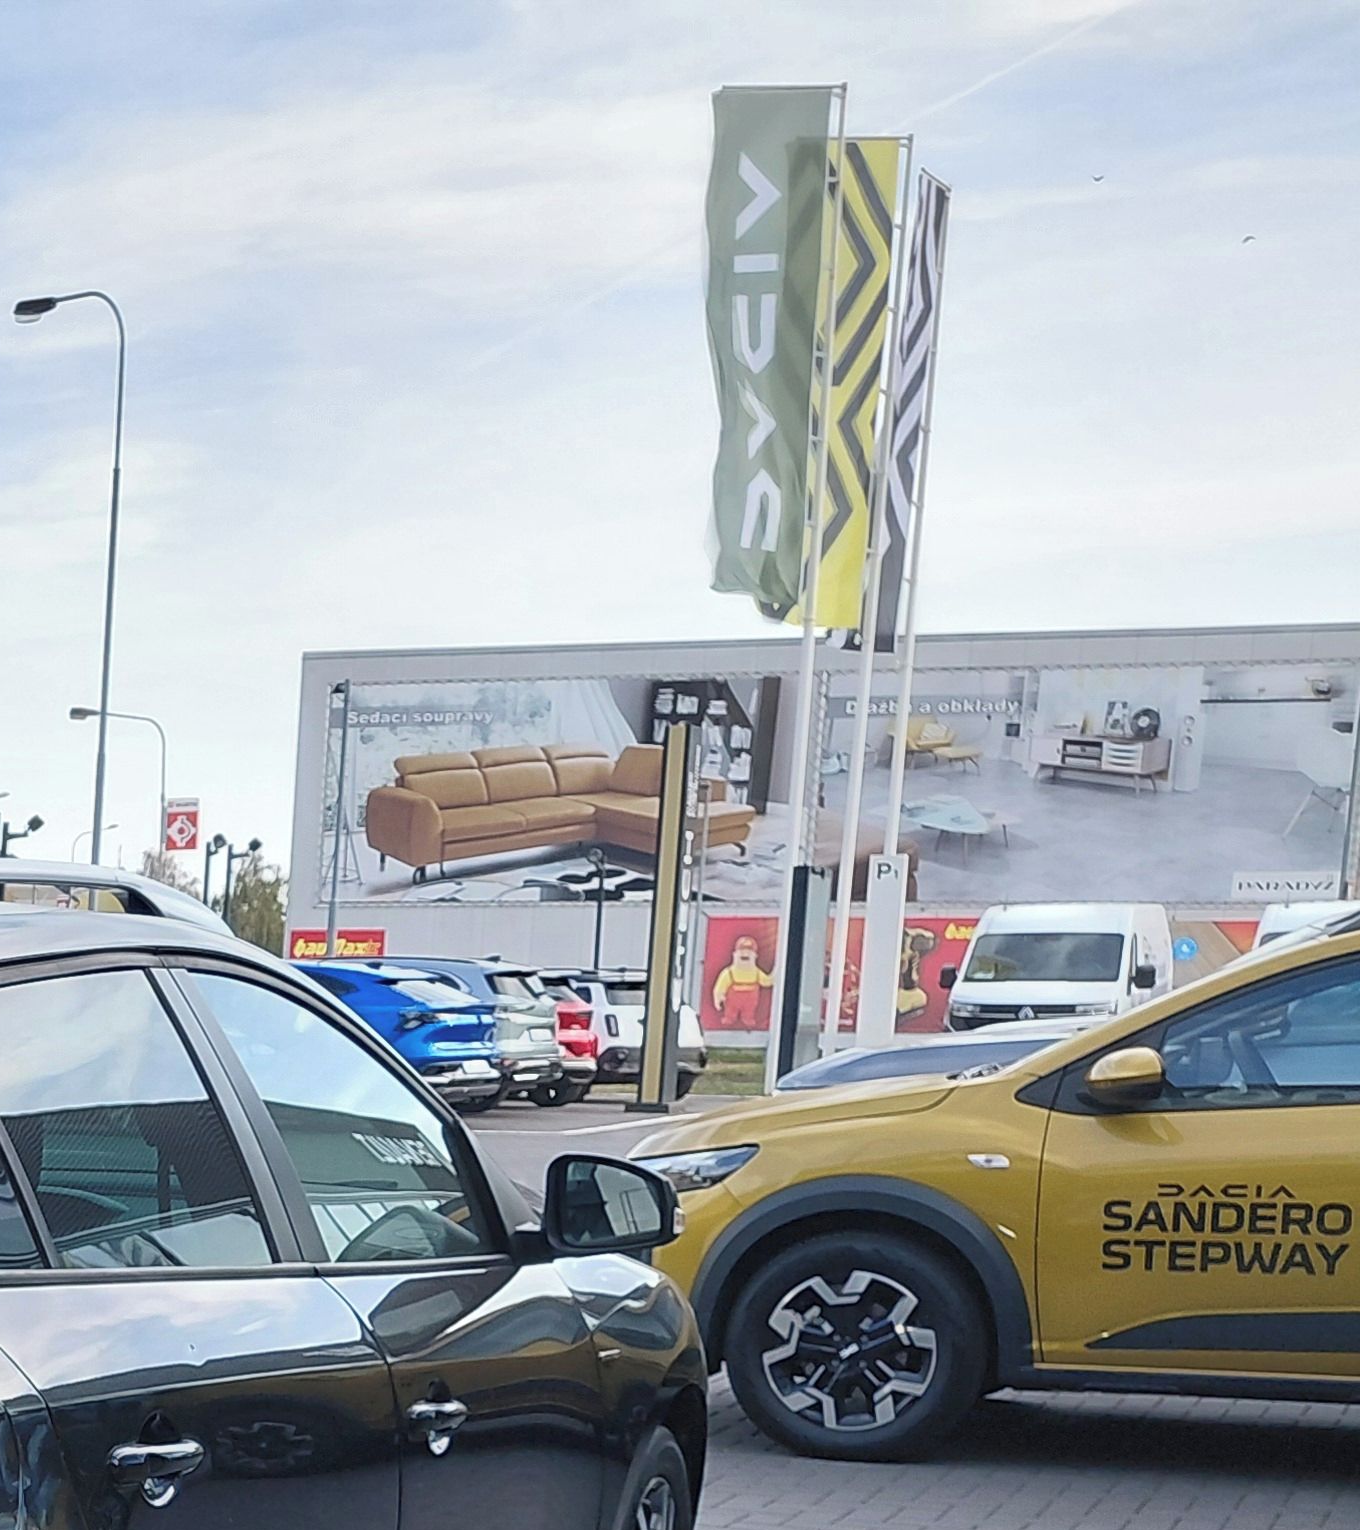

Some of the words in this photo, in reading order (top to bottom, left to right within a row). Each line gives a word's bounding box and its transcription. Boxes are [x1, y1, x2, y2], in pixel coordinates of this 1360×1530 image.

[919, 702, 931, 713] a
[937, 699, 1021, 716] obklady
[412, 710, 494, 725] soupravy
[1157, 1183, 1297, 1199] DACIA
[1102, 1200, 1353, 1236] SANDERO
[1101, 1239, 1350, 1276] STEPWAY
